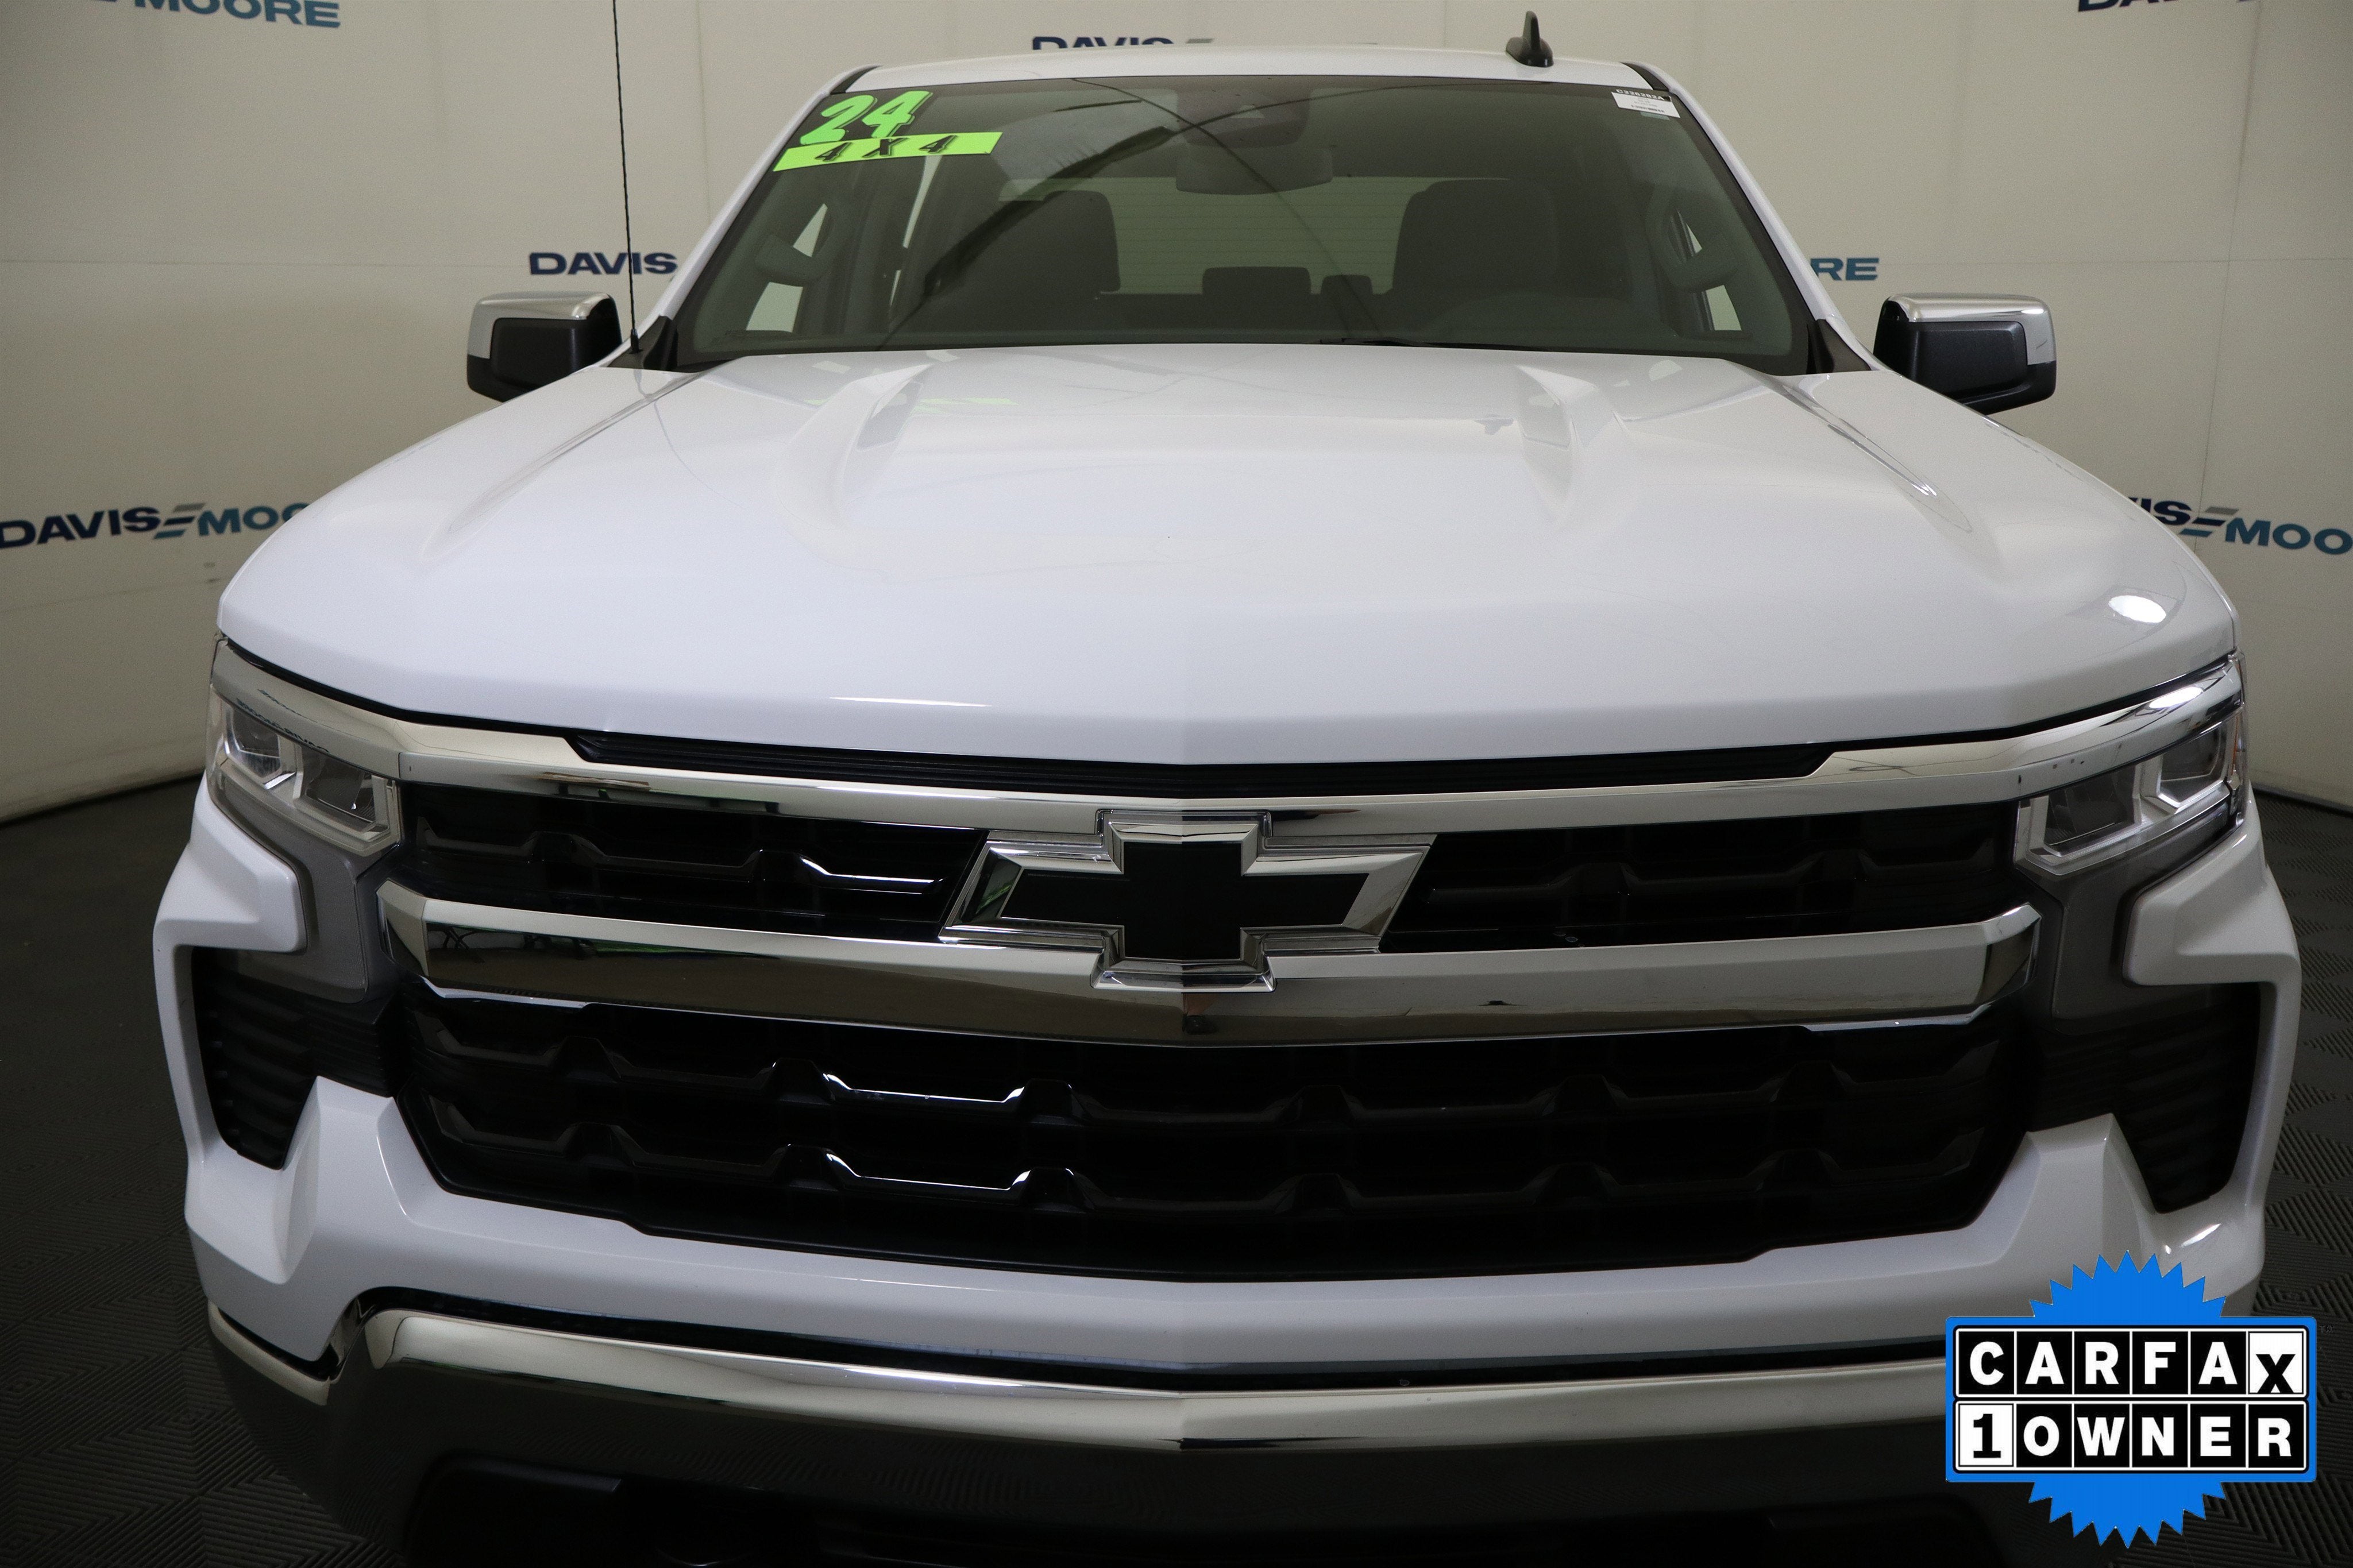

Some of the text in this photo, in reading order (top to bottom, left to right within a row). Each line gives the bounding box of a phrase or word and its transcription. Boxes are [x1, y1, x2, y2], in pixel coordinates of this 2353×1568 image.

[800, 90, 934, 145] 24
[529, 252, 678, 275] DAVIS
[0, 507, 160, 549] DAVIS
